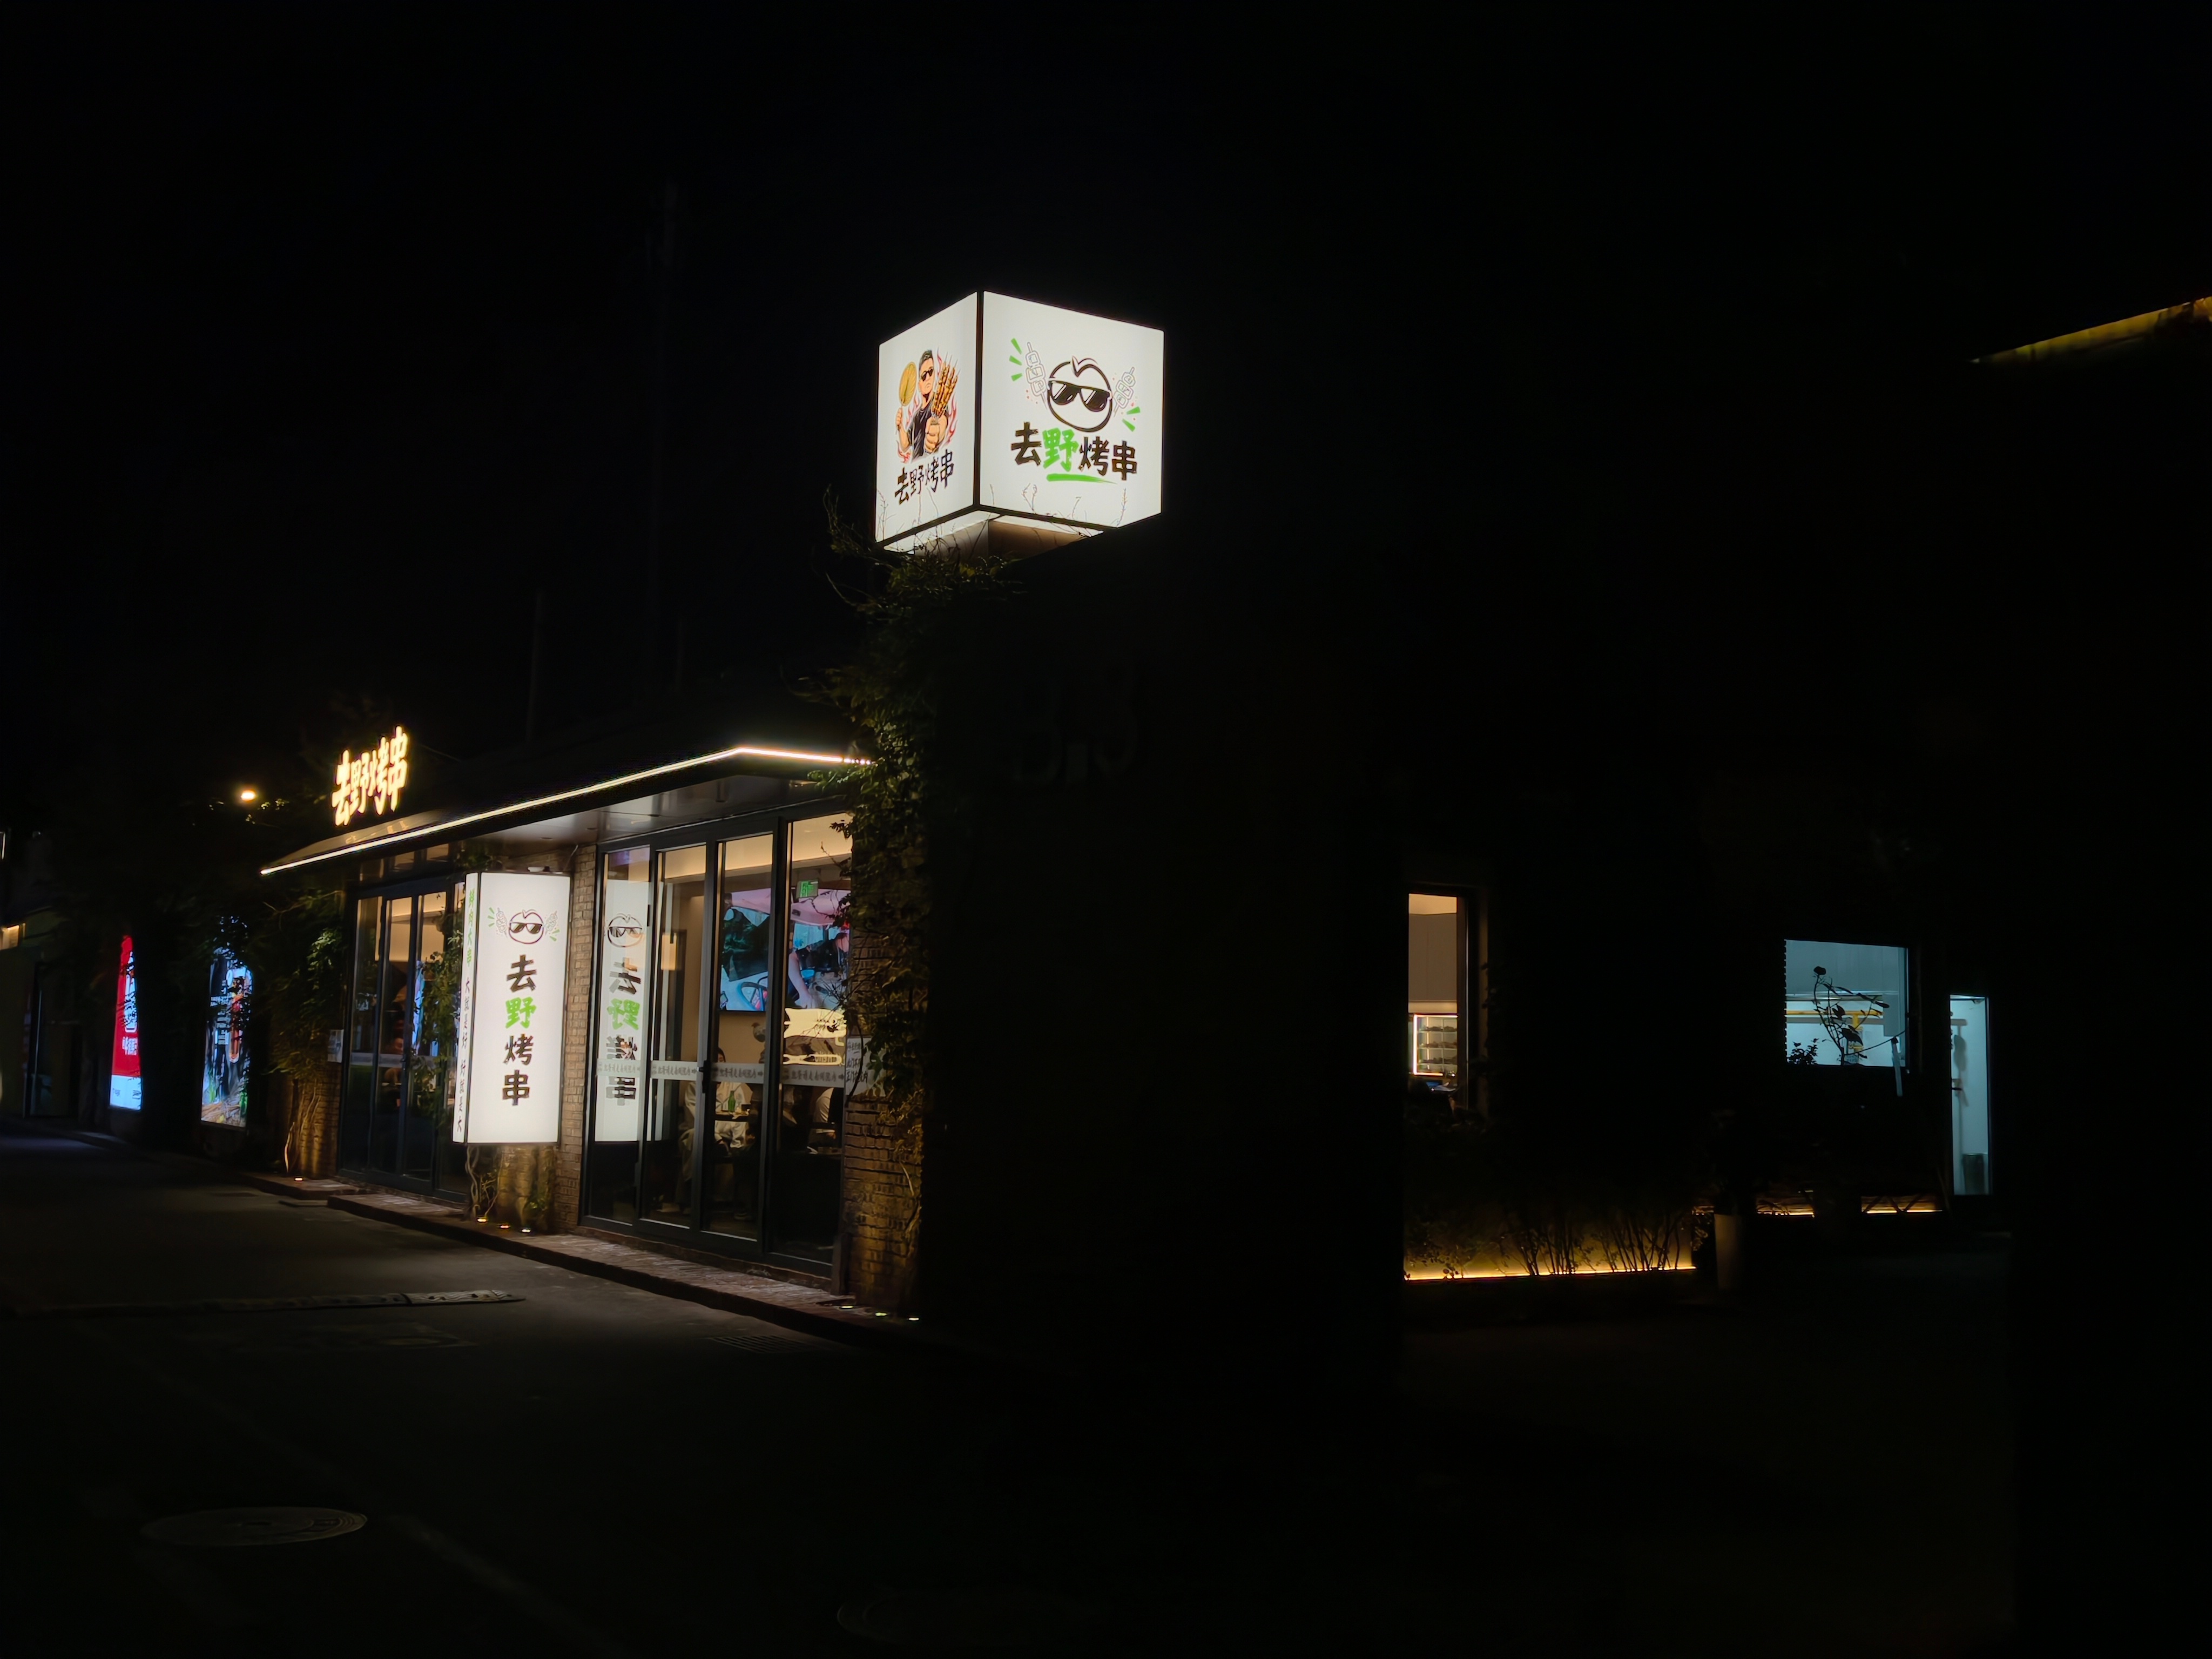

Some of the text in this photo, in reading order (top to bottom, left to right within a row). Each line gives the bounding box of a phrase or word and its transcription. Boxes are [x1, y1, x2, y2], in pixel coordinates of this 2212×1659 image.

[894, 449, 954, 505] 去野烤串
[1010, 422, 1137, 481] 去野烤串
[332, 725, 408, 826] 去野烤串
[502, 954, 537, 1106] 去野烤串
